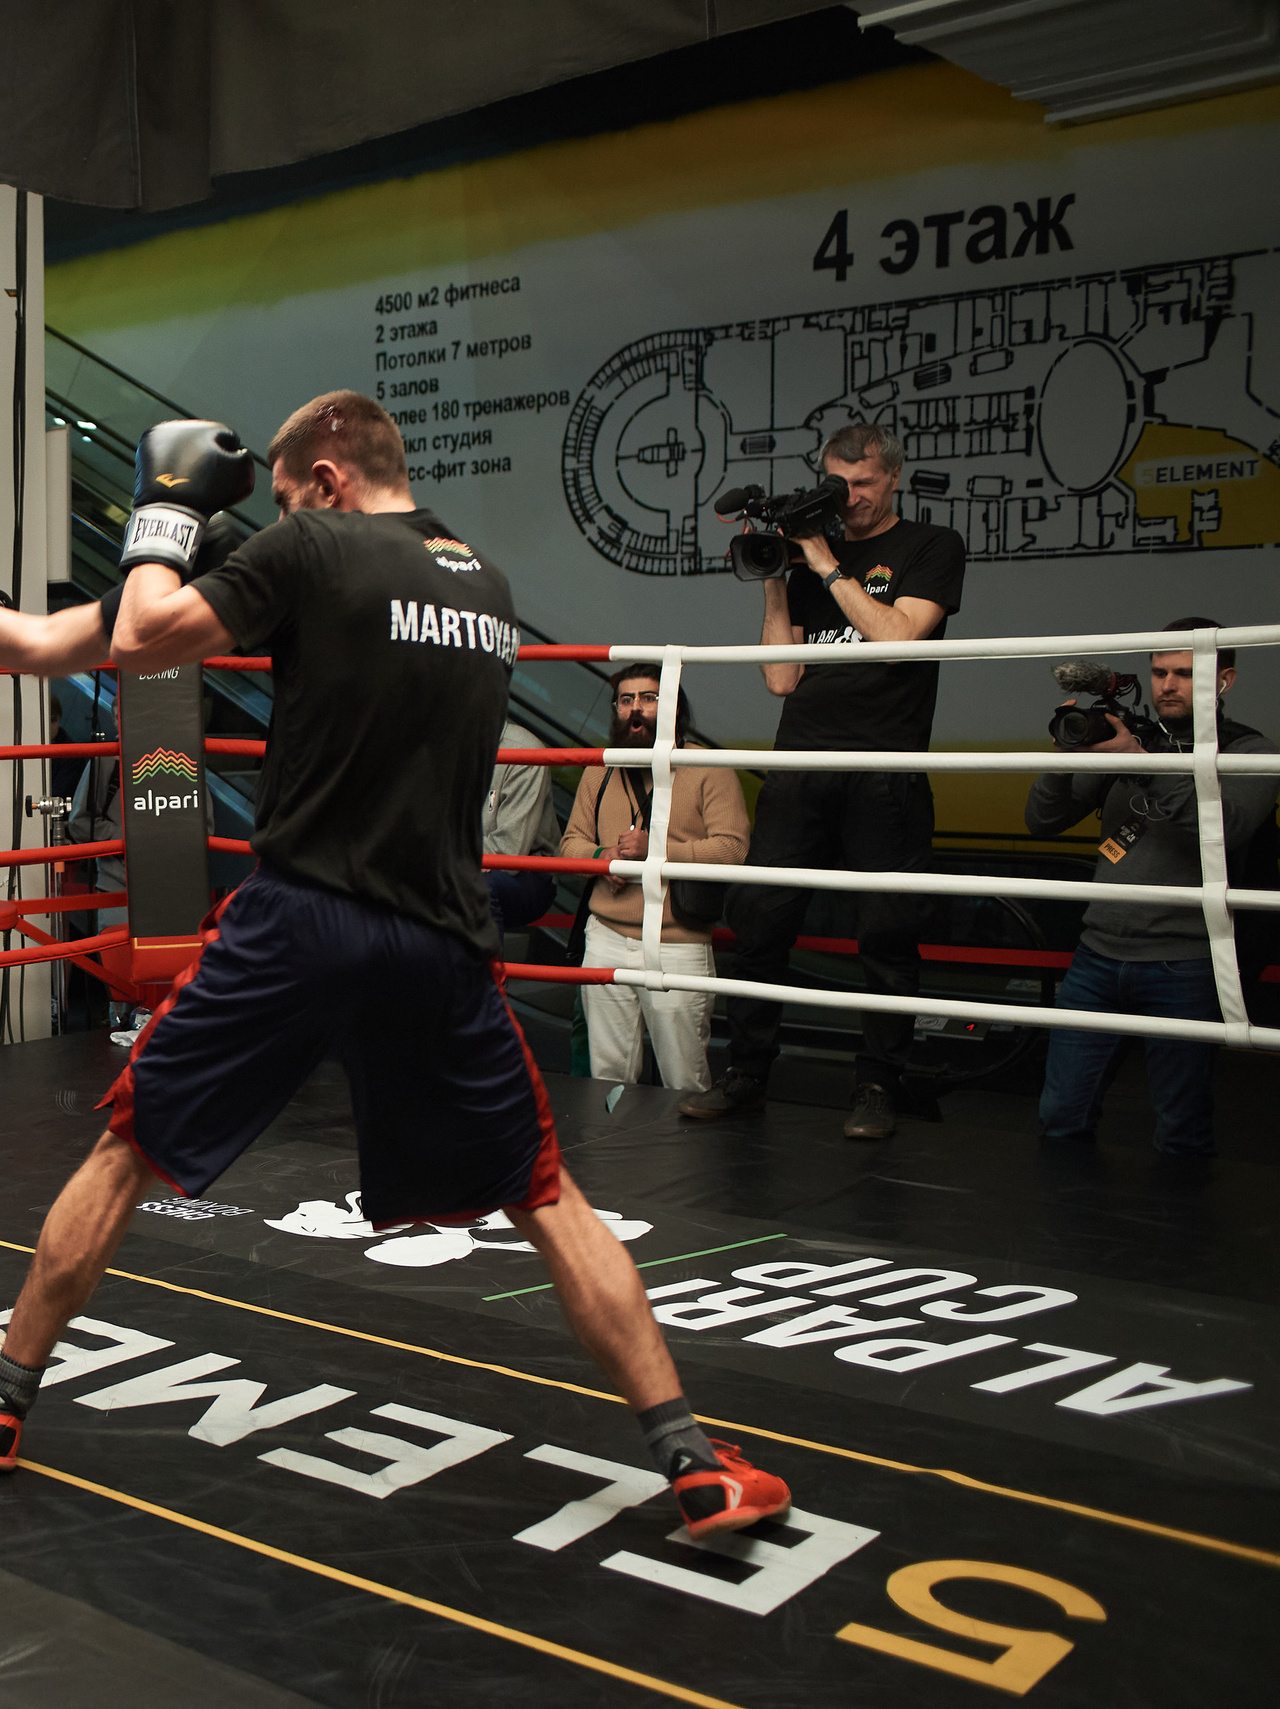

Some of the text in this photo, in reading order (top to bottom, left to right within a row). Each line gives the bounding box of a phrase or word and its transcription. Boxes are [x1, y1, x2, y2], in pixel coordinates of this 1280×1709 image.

[812, 192, 1076, 282] 4 этаж
[375, 276, 521, 315] 4500 м2 фитнеса
[375, 319, 438, 343] 2 этажа
[376, 334, 532, 372] Потолки 7 метров
[376, 377, 439, 400] 5 залов
[391, 389, 570, 427] олее 180 тренажеров
[432, 429, 492, 453] студия
[408, 456, 511, 483] сс-фит зона
[133, 517, 195, 551] EVERLAST
[863, 582, 889, 596] lpari
[133, 789, 198, 816] alpari
[1103, 843, 1121, 859] PRESS
[731, 1257, 1078, 1322] CUP
[645, 1278, 1255, 1415] ALPARI
